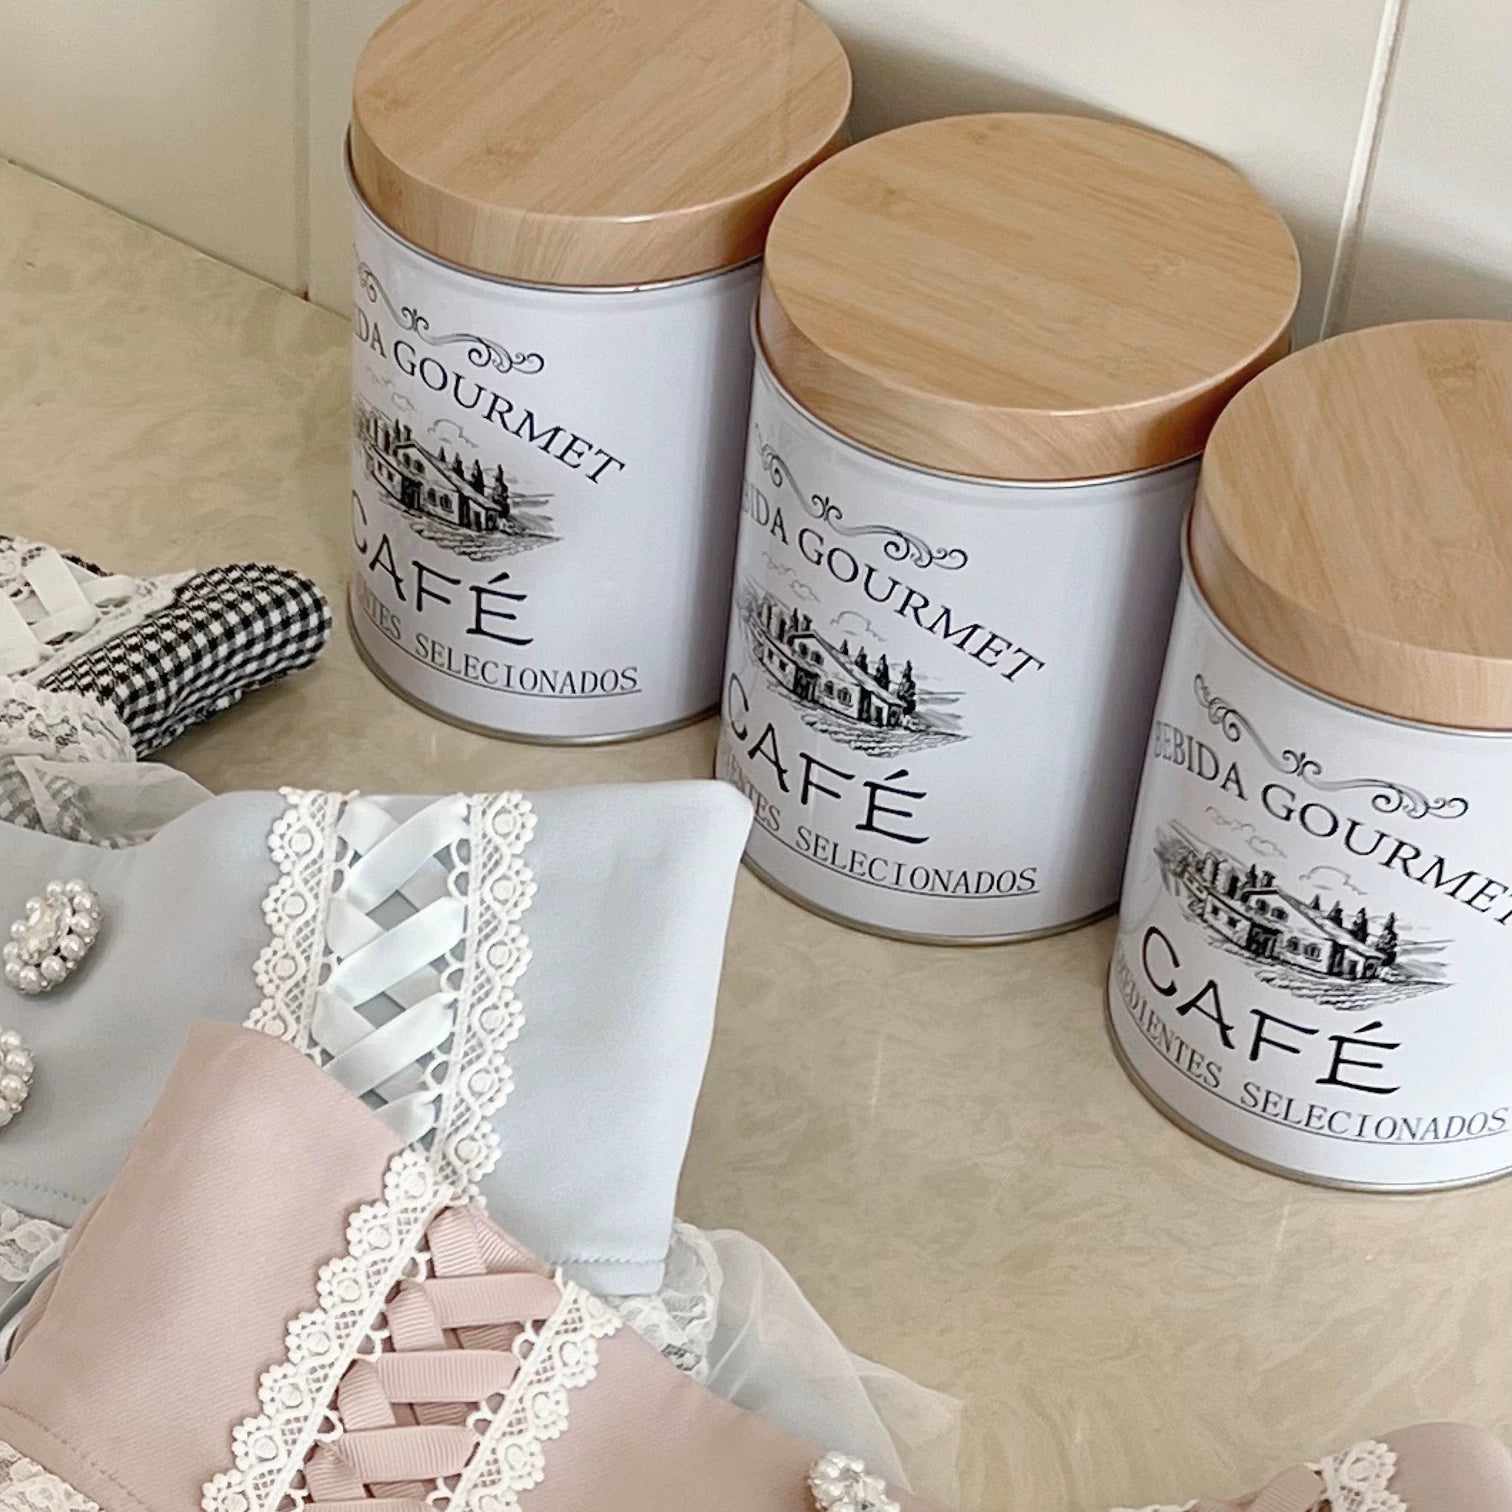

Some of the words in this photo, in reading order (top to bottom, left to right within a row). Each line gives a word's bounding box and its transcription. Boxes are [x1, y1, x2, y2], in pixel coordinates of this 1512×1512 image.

[393, 340, 626, 485] GOURMET
[351, 489, 534, 646] CAFÉ
[798, 527, 1045, 684] GOURMET
[415, 632, 638, 695] SELECIONADOS
[728, 673, 930, 845] CAFÉ
[795, 825, 1039, 895] SELECIONADOS
[1141, 926, 1402, 1095] CAFÉ
[1240, 1081, 1510, 1142] SELECIONADOS
